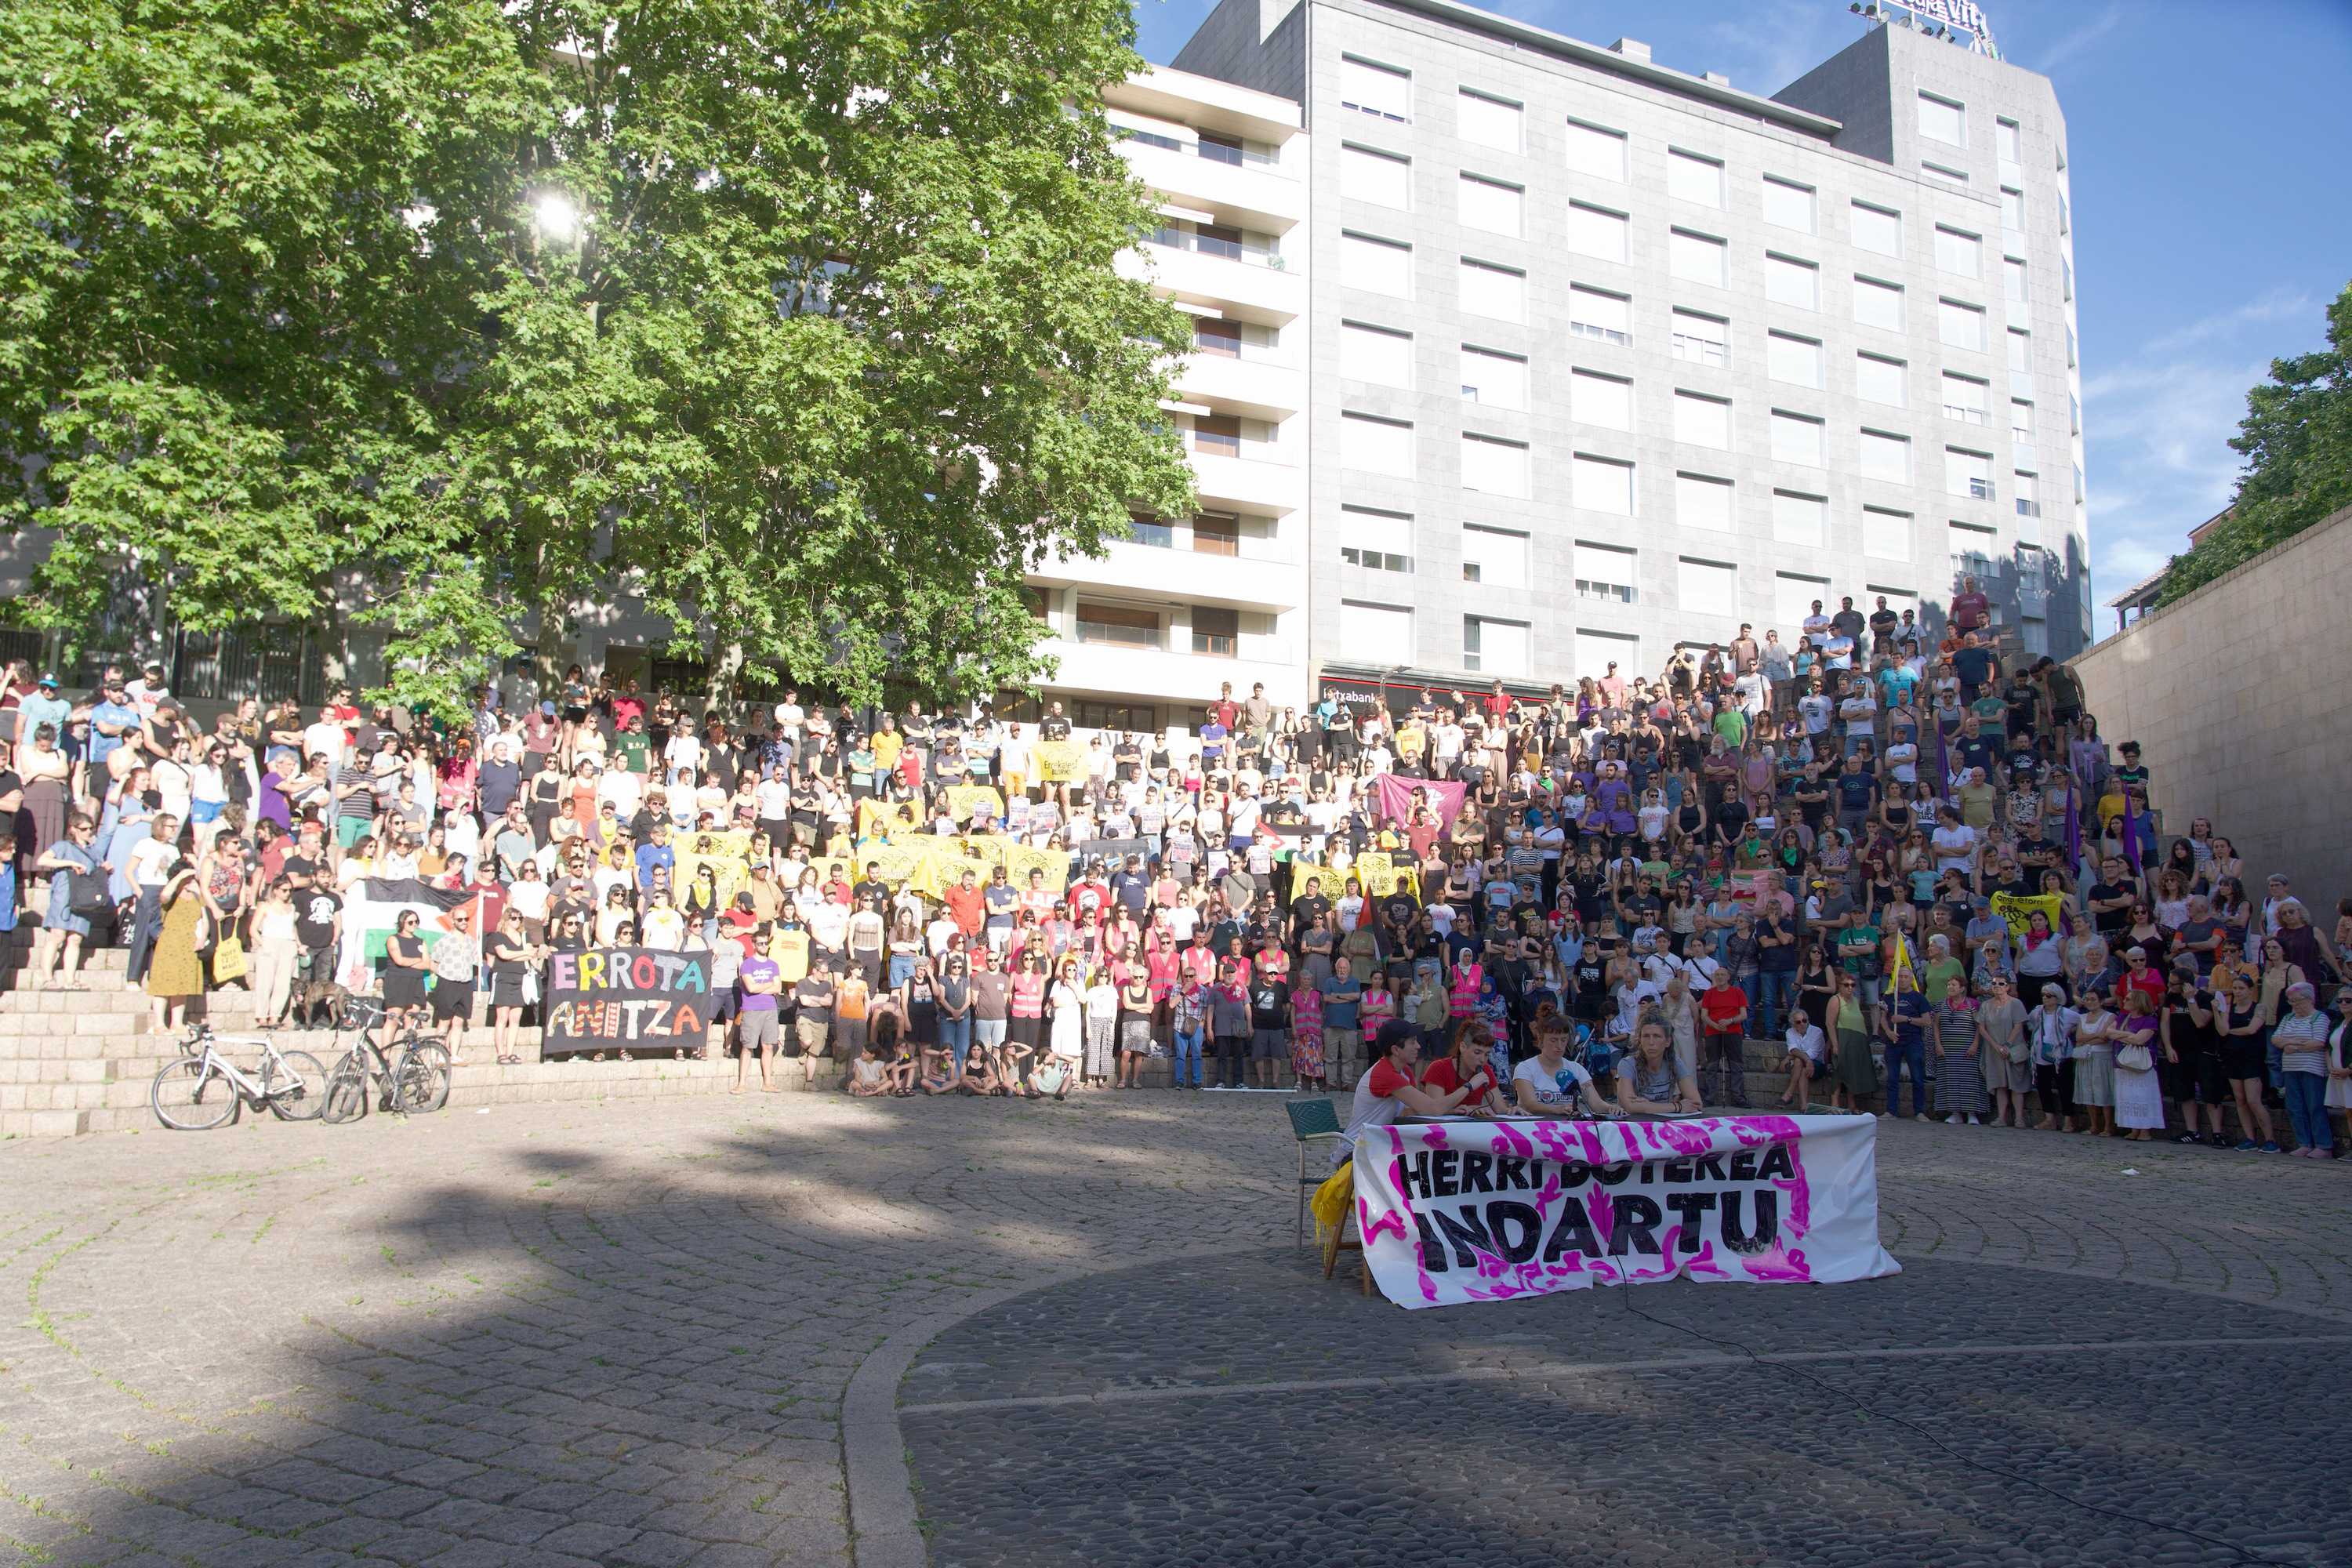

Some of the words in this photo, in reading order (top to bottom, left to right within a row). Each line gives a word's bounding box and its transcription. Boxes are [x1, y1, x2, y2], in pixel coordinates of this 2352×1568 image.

[1323, 688, 1377, 703] txabank
[878, 867, 916, 879] rrekaleor
[1021, 891, 1057, 909] LAB
[2017, 897, 2043, 906] etorri
[554, 952, 706, 993] ERROTA
[547, 1000, 702, 1040] ANITZA
[1396, 1149, 1549, 1200] HERRI
[1414, 1189, 1779, 1273] INDARTU
